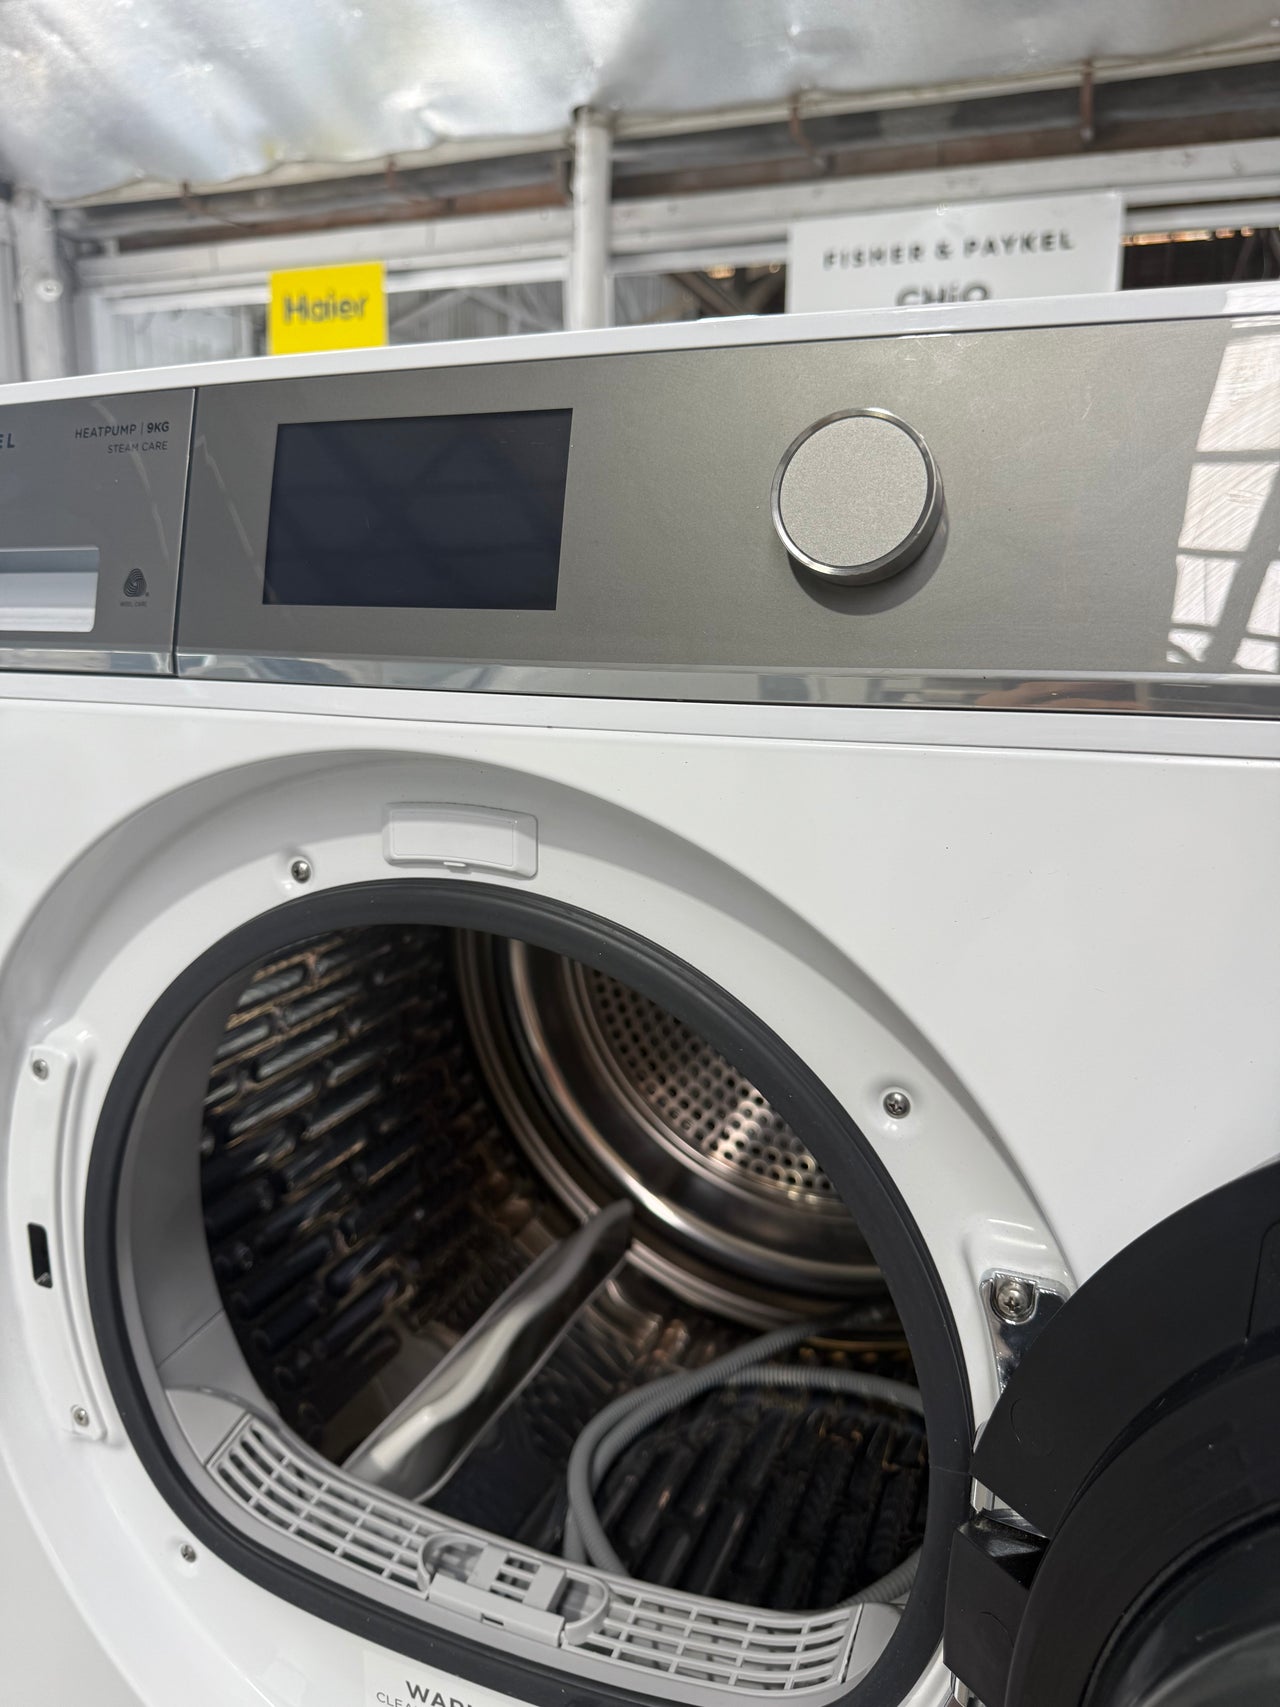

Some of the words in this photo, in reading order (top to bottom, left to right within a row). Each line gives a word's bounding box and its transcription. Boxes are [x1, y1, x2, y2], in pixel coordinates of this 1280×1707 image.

[823, 243, 924, 270] FISHER
[935, 239, 952, 261] &
[963, 230, 1075, 257] PAYKEL
[283, 289, 369, 325] Haier
[75, 423, 137, 439] HEATPUMP
[147, 421, 170, 434] 9KG
[107, 443, 139, 454] STEAM
[142, 440, 168, 451] CARE
